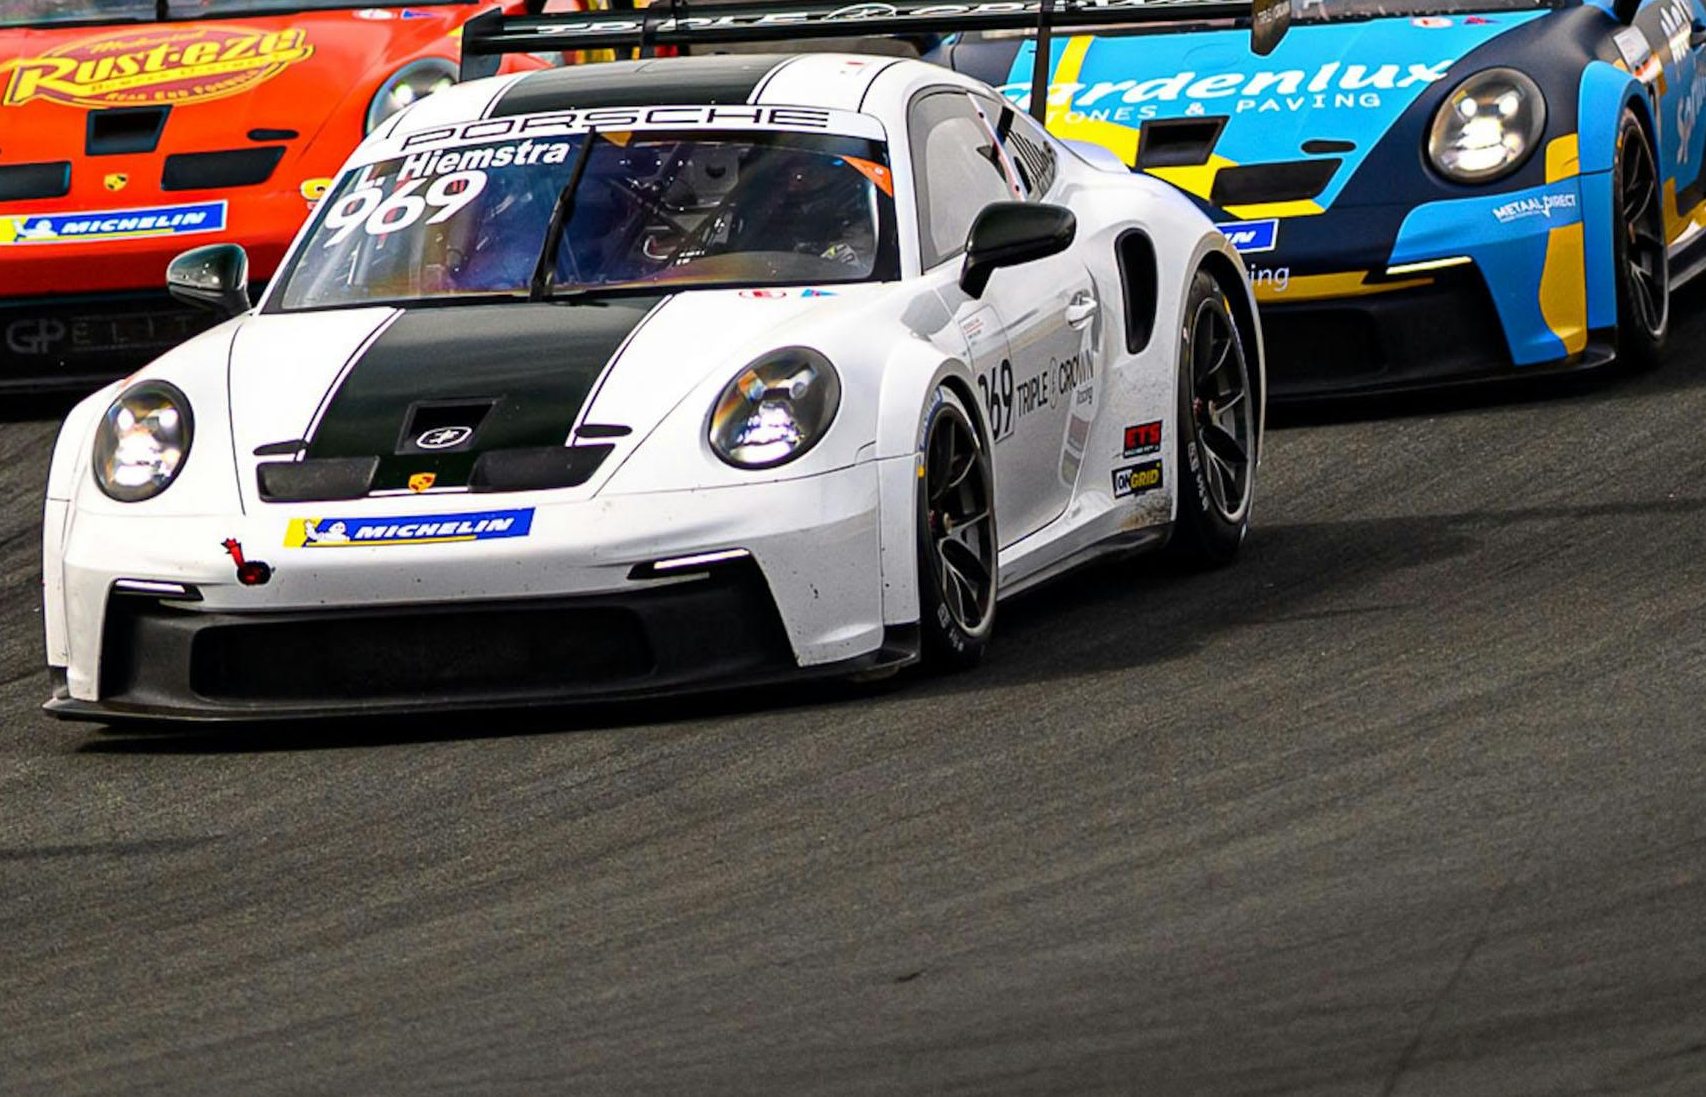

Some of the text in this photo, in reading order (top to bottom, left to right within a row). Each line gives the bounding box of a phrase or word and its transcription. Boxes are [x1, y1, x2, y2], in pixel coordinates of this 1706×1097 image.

[1236, 93, 1381, 113] PAVING
[401, 106, 829, 152] PORSCHE
[357, 139, 570, 190] L. Hiemstra
[61, 212, 207, 234] MICHELIN
[324, 170, 488, 248] 969
[6, 319, 65, 354] GP
[1126, 422, 1161, 448] ETS
[355, 517, 514, 541] MICHELIN
